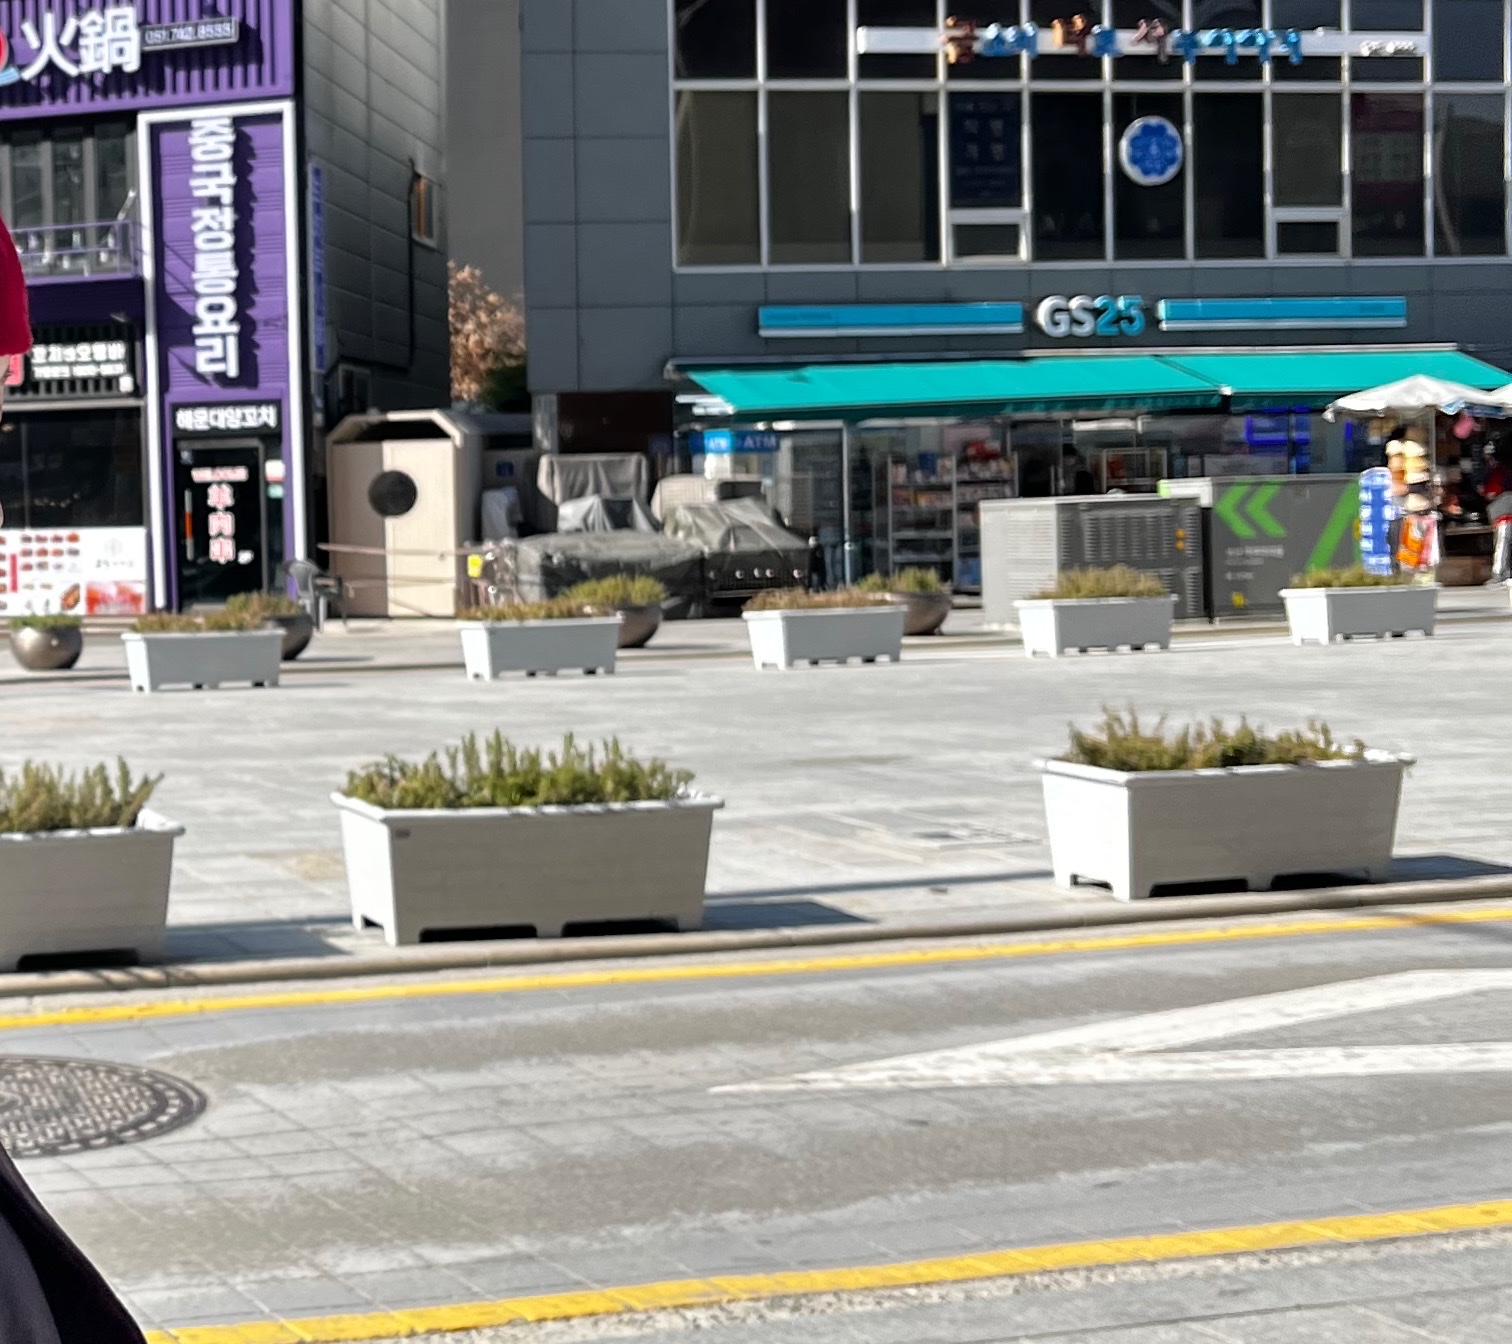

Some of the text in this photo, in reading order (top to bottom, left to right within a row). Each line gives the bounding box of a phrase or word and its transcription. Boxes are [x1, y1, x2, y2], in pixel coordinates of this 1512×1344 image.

[20, 6, 141, 81] 火鍋
[1036, 295, 1145, 337] GS25
[743, 435, 777, 449] ATM
